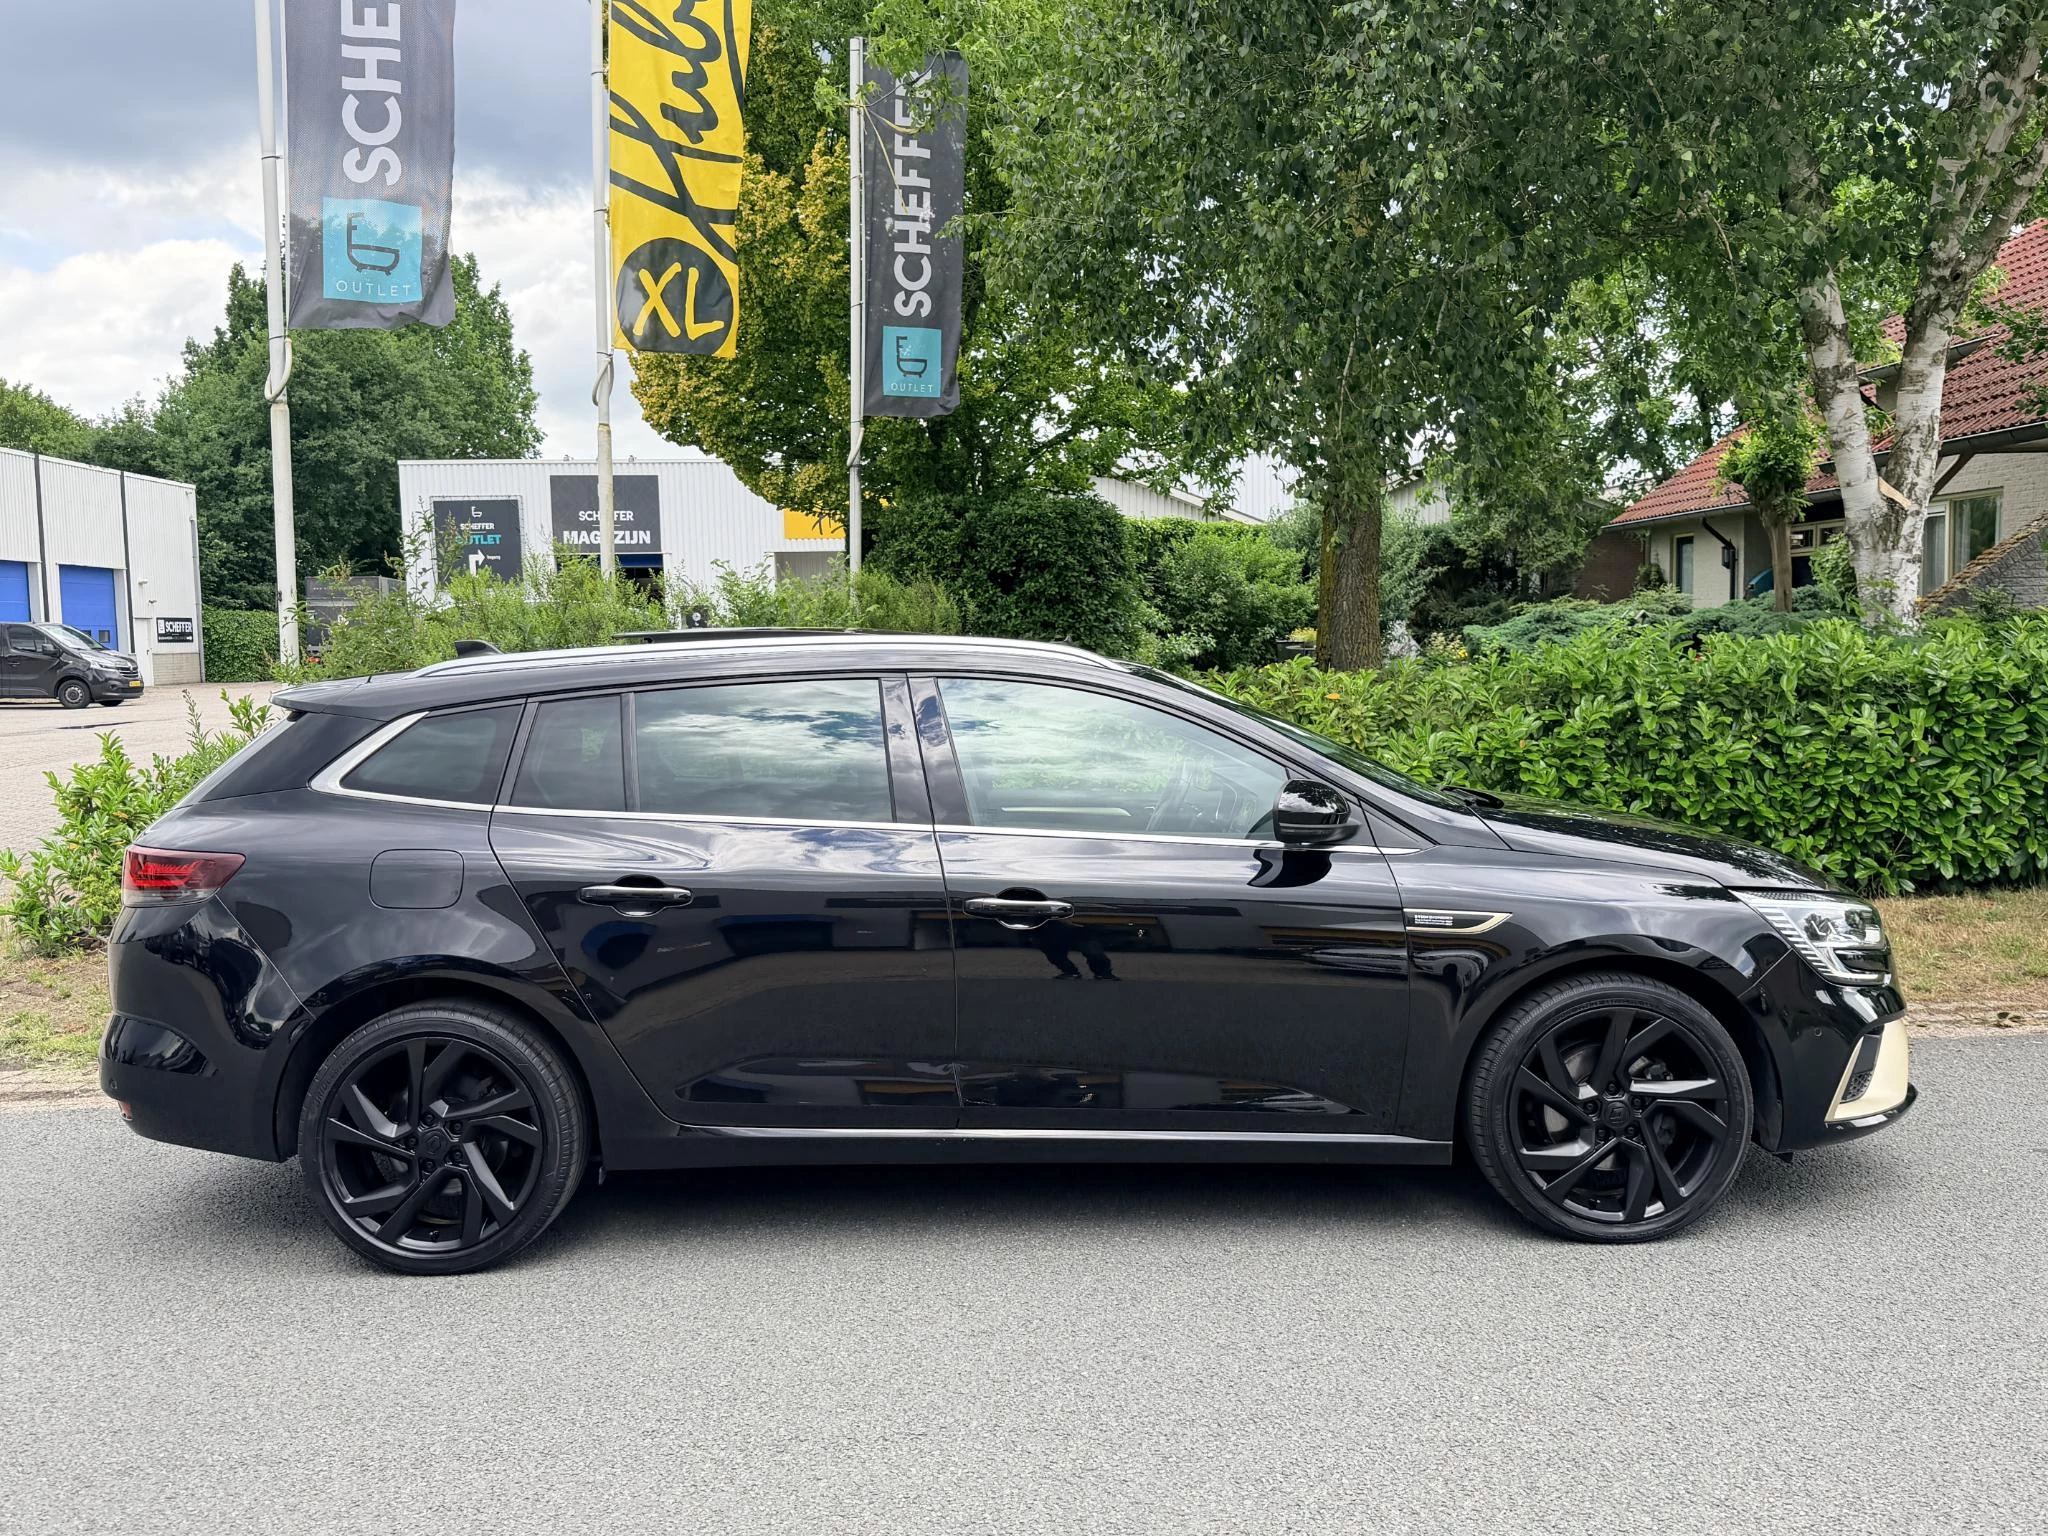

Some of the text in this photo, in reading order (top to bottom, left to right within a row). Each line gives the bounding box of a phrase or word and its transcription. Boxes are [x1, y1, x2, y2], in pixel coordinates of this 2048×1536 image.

[336, 280, 412, 298] OUTLET
[632, 262, 726, 341] XL
[890, 382, 934, 394] OUTLET
[578, 510, 635, 522] SCHFER
[562, 530, 652, 545] MAGZIJN
[165, 621, 193, 633] SCHEFFER
